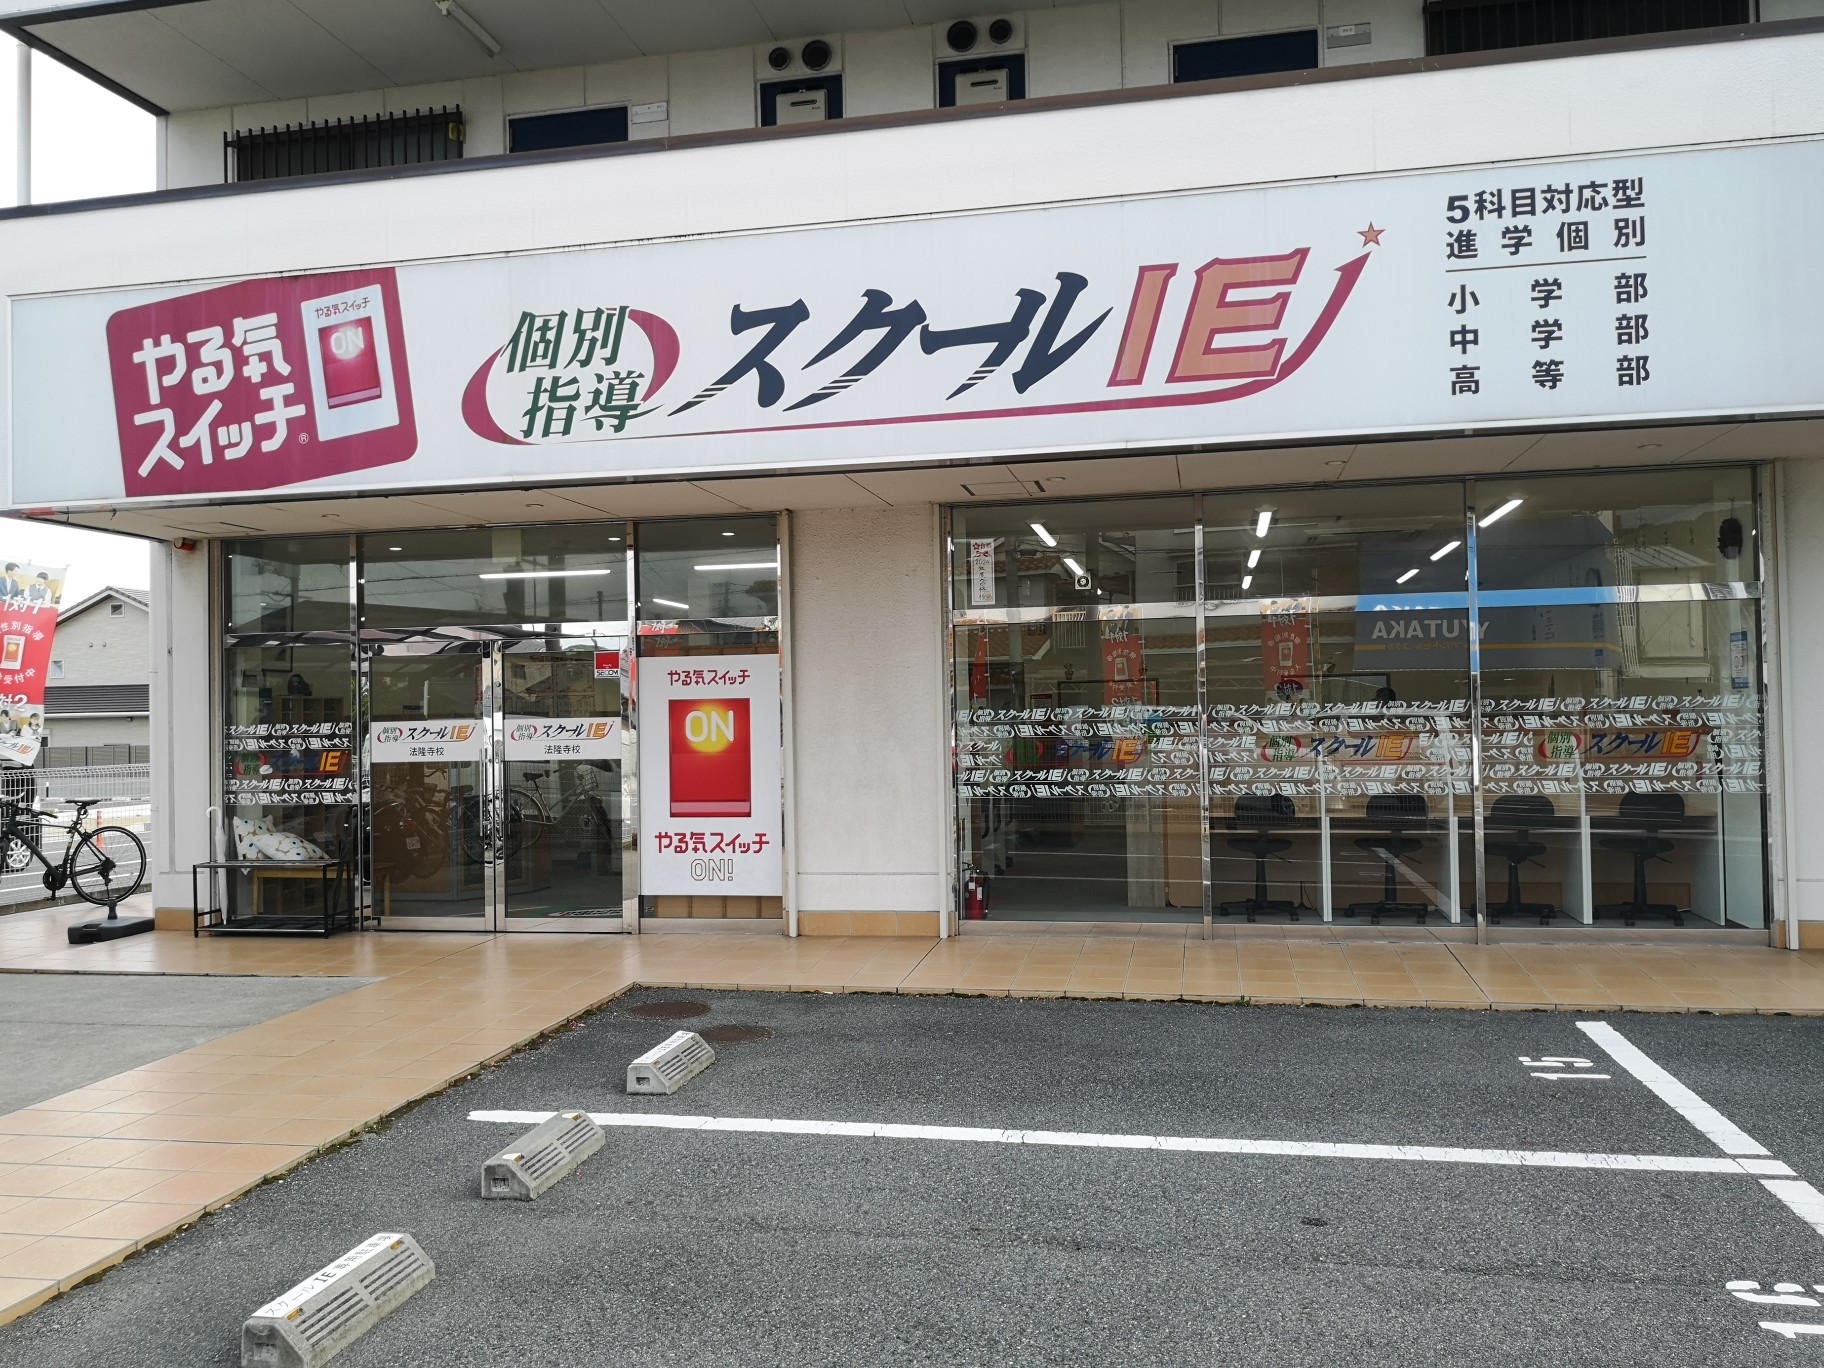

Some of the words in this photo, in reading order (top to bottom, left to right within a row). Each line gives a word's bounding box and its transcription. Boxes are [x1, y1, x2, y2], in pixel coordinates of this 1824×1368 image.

[1446, 177, 1646, 224] 5科目対応型
[1446, 216, 1646, 260] 進学個別
[1447, 271, 1649, 314] 小学部
[315, 297, 370, 319] やる気スイッチ
[330, 326, 365, 354] ON
[502, 306, 629, 375] 個別
[668, 247, 1312, 417] スクールIE
[1449, 313, 1650, 355] 中学部
[133, 311, 292, 404] やる気
[1449, 354, 1651, 397] 高等部
[519, 369, 656, 438] 指導
[134, 381, 306, 479] スイッチ
[3, 594, 43, 615] 1対1
[0, 620, 45, 641] 性別指導
[667, 669, 751, 687] やる気スイッチ
[402, 724, 470, 741] スクールIE
[540, 722, 609, 739] スクールIE
[685, 709, 735, 743] ON
[1547, 730, 1572, 744] 個別
[409, 746, 445, 757] 法隆寺校
[544, 744, 581, 755] 法隆寺校
[1302, 733, 1409, 759] スクールIE
[1550, 744, 1576, 759] 指導
[1581, 730, 1693, 757] スクールIE
[654, 832, 770, 855] やる気スイッチ
[690, 858, 735, 882] ON!
[1518, 1056, 1612, 1080] 15
